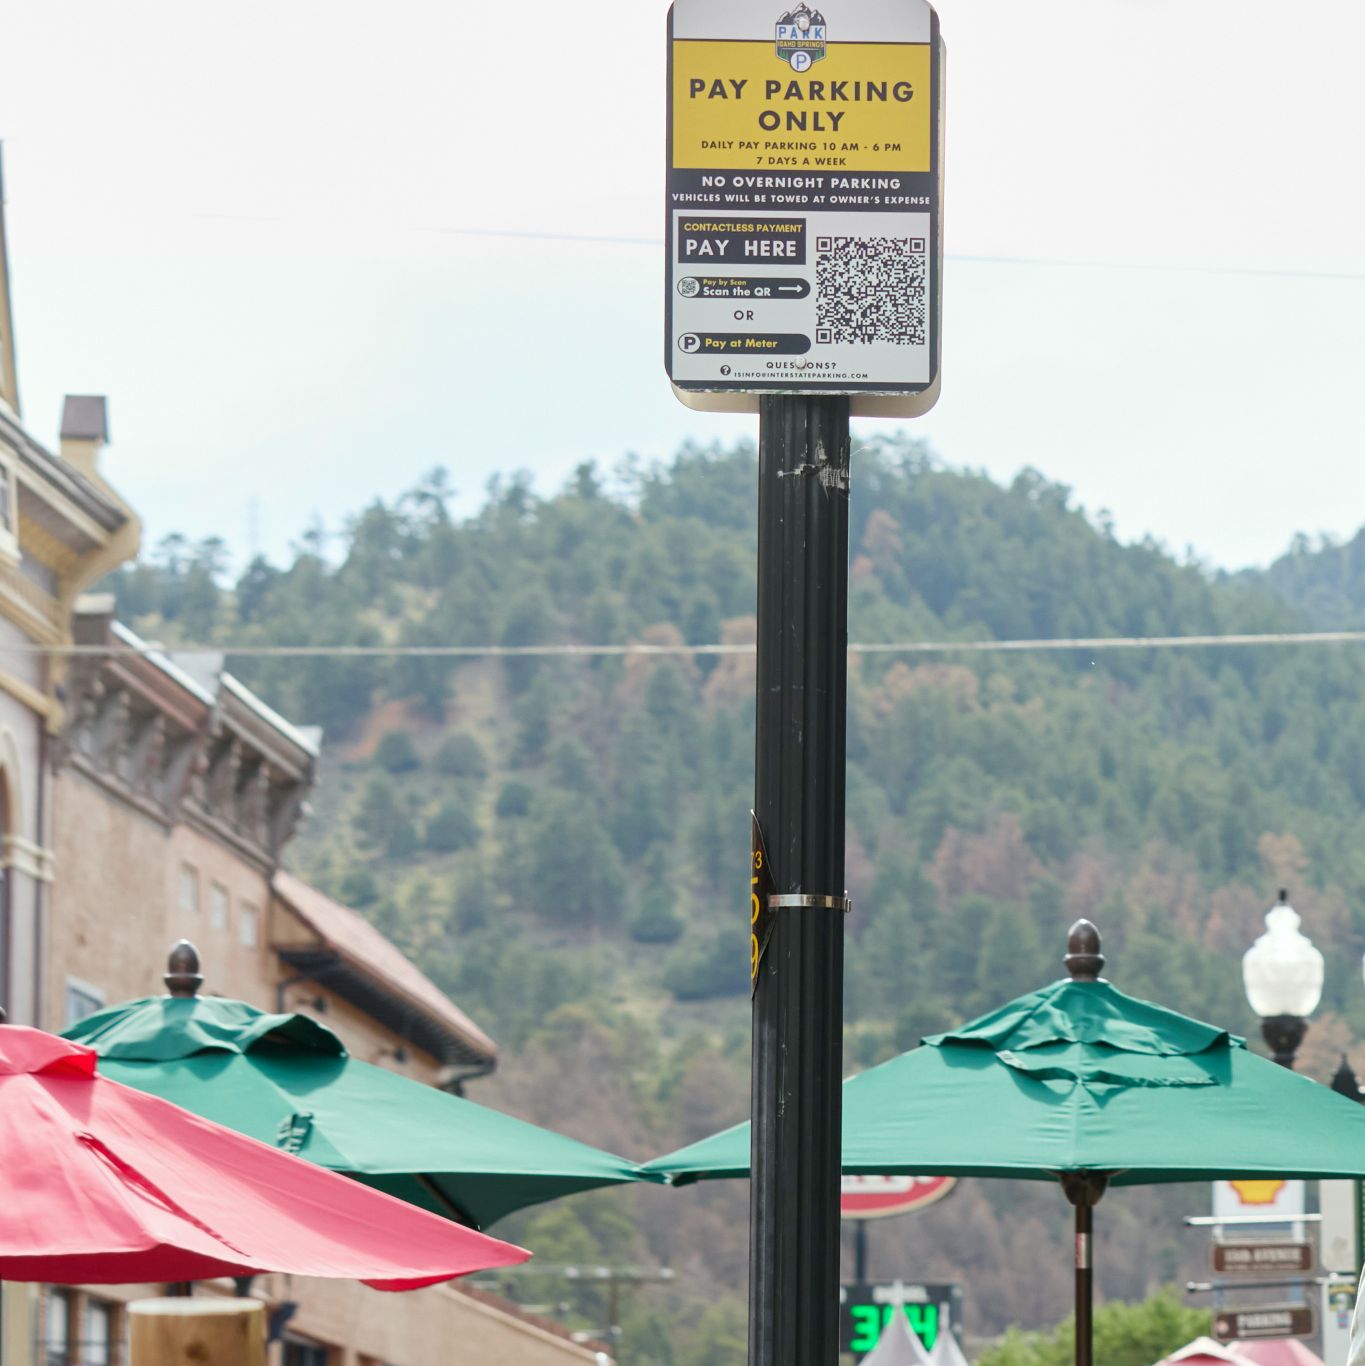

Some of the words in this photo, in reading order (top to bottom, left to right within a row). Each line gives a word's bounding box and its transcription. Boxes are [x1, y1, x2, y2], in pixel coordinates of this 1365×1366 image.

[777, 25, 824, 40] PARK
[777, 40, 797, 48] IDAHO
[689, 78, 748, 100] PAY
[765, 80, 914, 103] PARKING
[758, 110, 846, 132] ONLY
[701, 140, 734, 150] DAILY
[738, 140, 760, 150] PAY
[764, 141, 817, 151] PARKING
[823, 142, 836, 151] 10
[841, 142, 860, 151] AM
[873, 142, 880, 152] 6
[884, 142, 902, 152] PM
[756, 156, 763, 165] 7
[768, 156, 798, 166] DAYS
[802, 157, 811, 166] A
[815, 157, 847, 167] WEEK
[702, 176, 726, 188] NO
[733, 176, 824, 189] OVERNIGHT
[831, 178, 901, 190] PARKING
[672, 193, 721, 203] VEHICLES
[725, 194, 750, 203] WILL
[754, 194, 767, 203] BE
[770, 194, 809, 204] TOWED
[812, 195, 826, 204] AT
[884, 196, 931, 205] EXPENSE
[684, 223, 755, 233] CONTACTLESS
[756, 223, 803, 233] PAYMENT
[685, 239, 729, 256] PAY
[744, 240, 797, 257] HERE
[703, 279, 717, 287] Pay
[718, 279, 728, 288] by
[730, 279, 747, 287] Scan
[703, 286, 730, 297] Scan
[733, 286, 751, 297] the
[754, 286, 771, 298] QR
[733, 310, 755, 321] OR
[704, 338, 728, 351] Pay
[730, 339, 742, 348] at
[744, 338, 778, 348] Meter
[766, 361, 837, 370] QUESONS?
